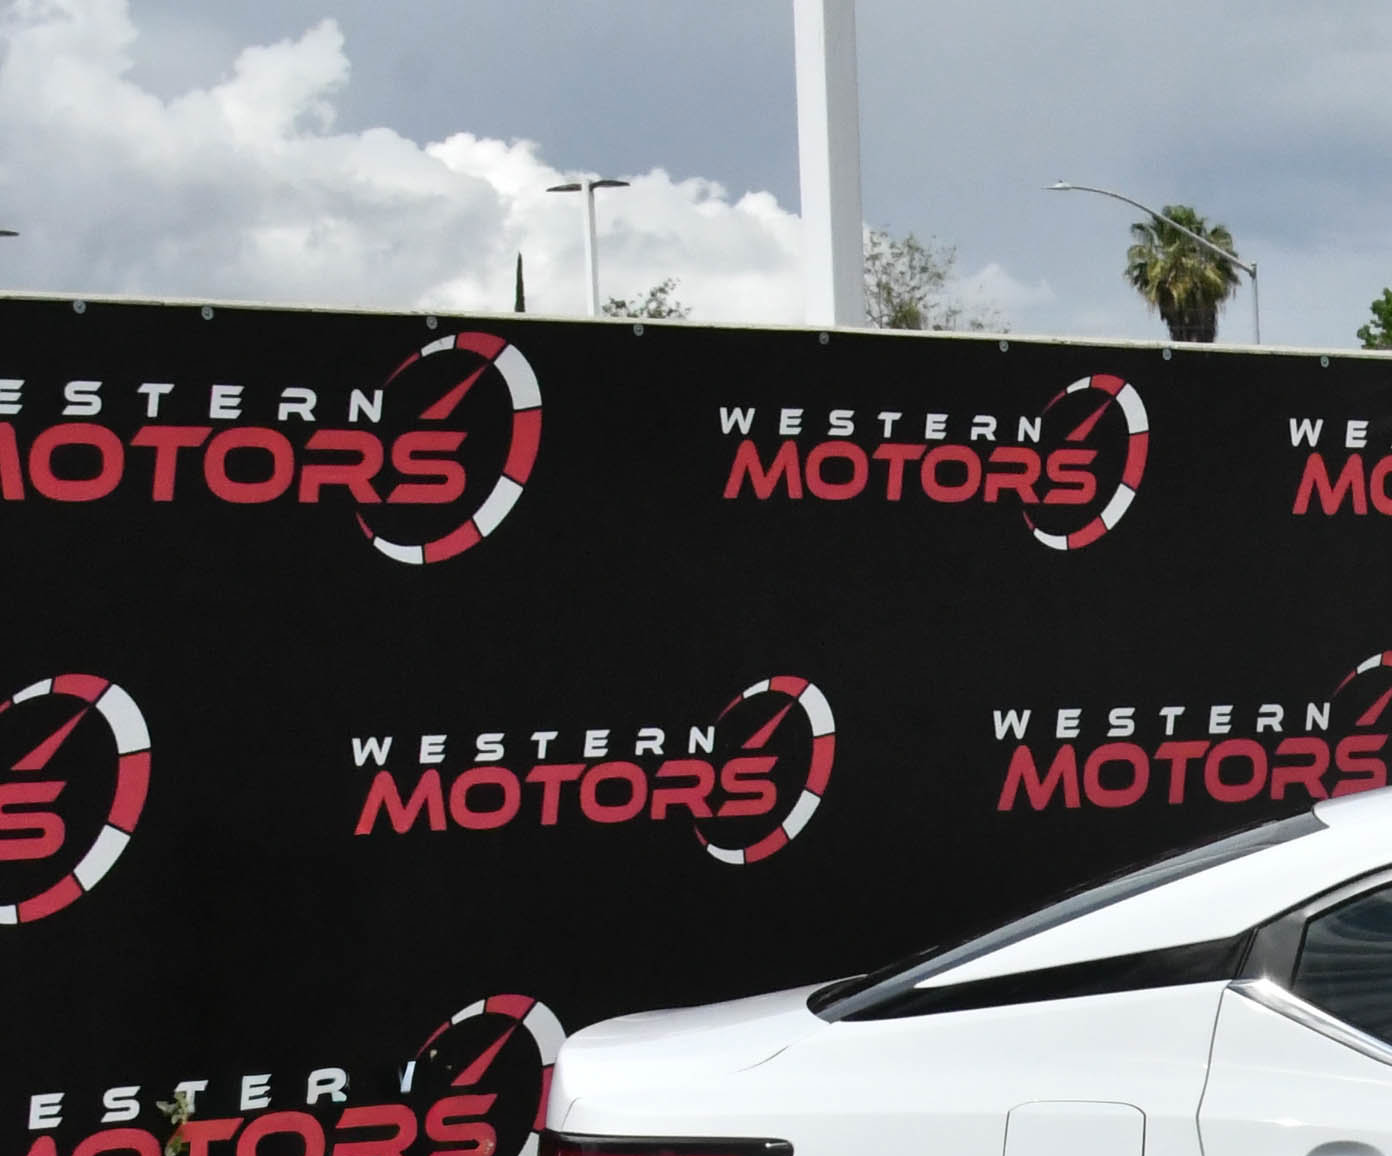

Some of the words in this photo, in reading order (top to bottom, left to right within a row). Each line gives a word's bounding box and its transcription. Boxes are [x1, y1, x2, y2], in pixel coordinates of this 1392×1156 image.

[719, 407, 1042, 443] WESTERN
[0, 422, 467, 504] OTORS
[723, 439, 1097, 505] MOTORS
[351, 725, 715, 767] WESTERN
[993, 702, 1331, 740] WESTERN
[354, 755, 779, 836] MOTORS
[997, 733, 1388, 811] MOTORS
